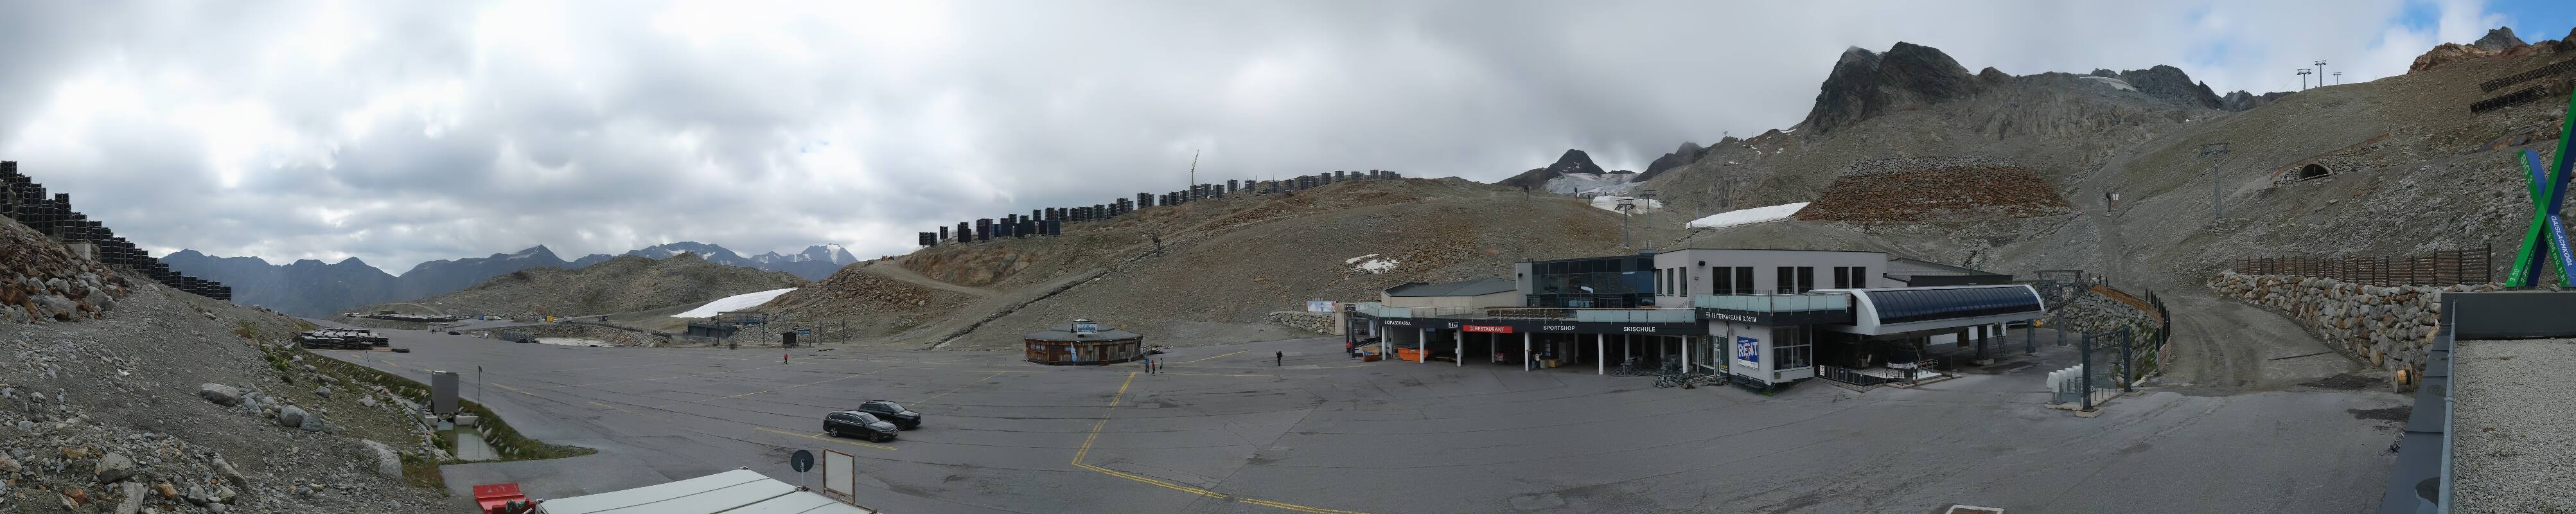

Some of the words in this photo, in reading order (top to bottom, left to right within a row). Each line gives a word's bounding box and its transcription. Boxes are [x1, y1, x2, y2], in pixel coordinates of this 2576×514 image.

[2520, 154, 2530, 175] BIG
[2527, 175, 2533, 184] 3
[2551, 215, 2573, 266] GAISLACHKOGL
[2510, 265, 2520, 282] 3.30
